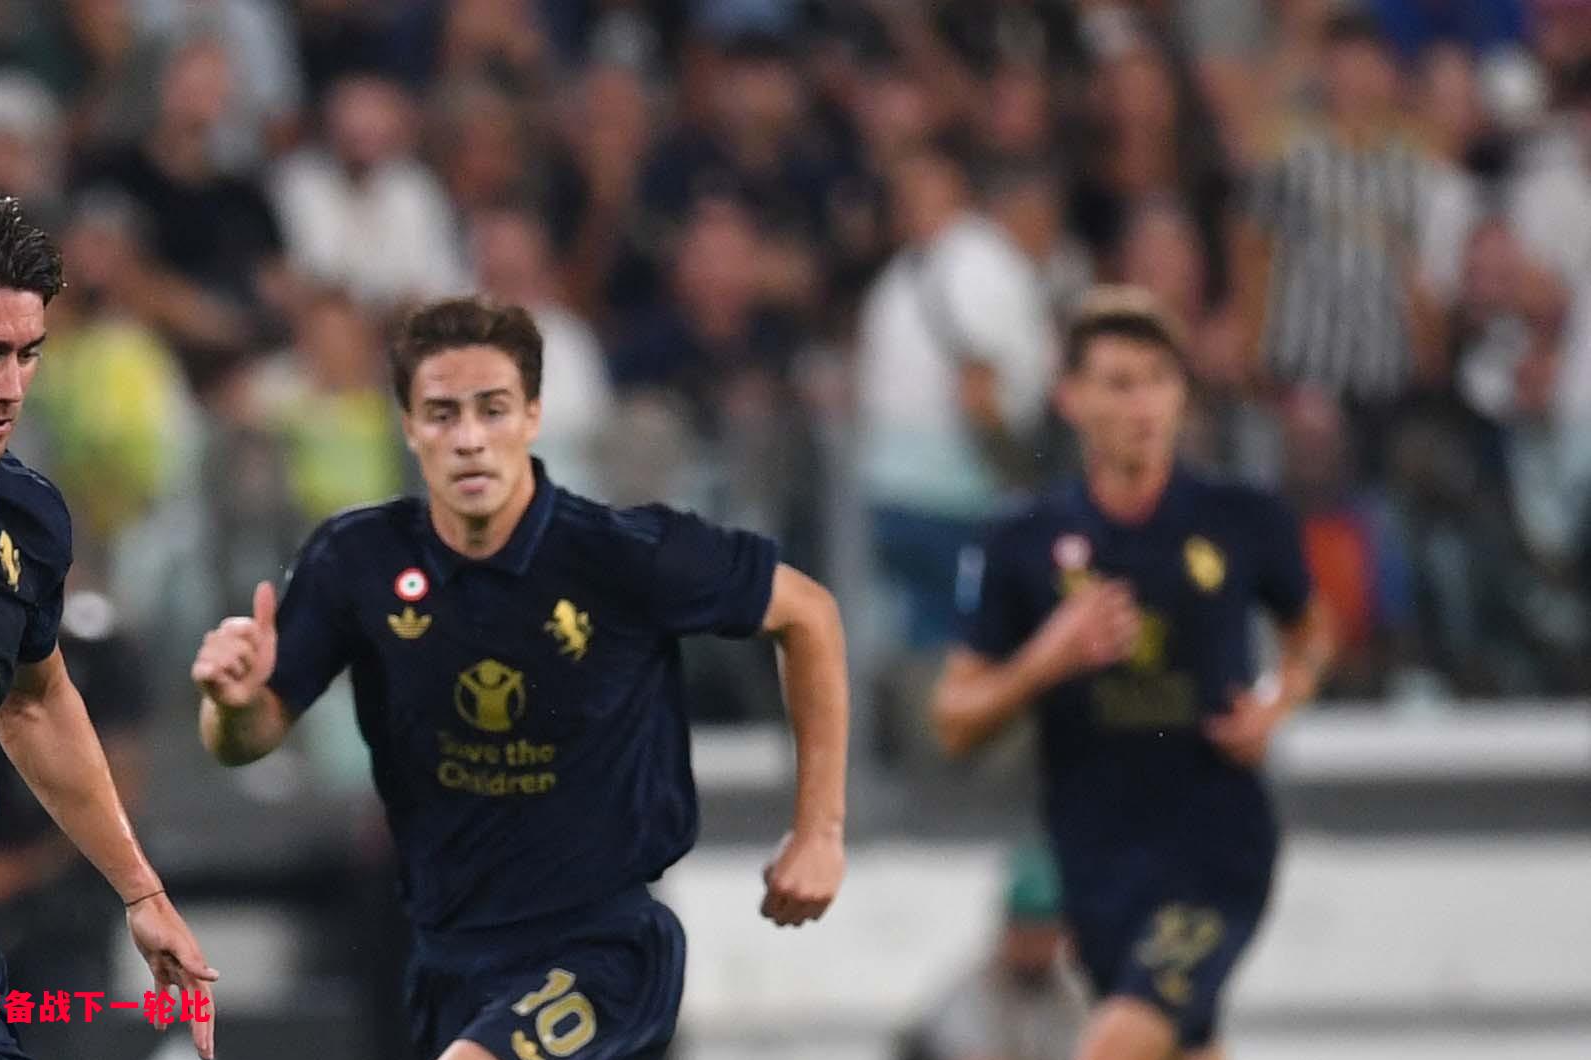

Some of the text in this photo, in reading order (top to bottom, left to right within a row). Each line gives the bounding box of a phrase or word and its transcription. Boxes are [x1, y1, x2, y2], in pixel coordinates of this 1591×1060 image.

[437, 737, 501, 765] ave
[436, 759, 557, 796] Cldren
[510, 967, 598, 1058] 10
